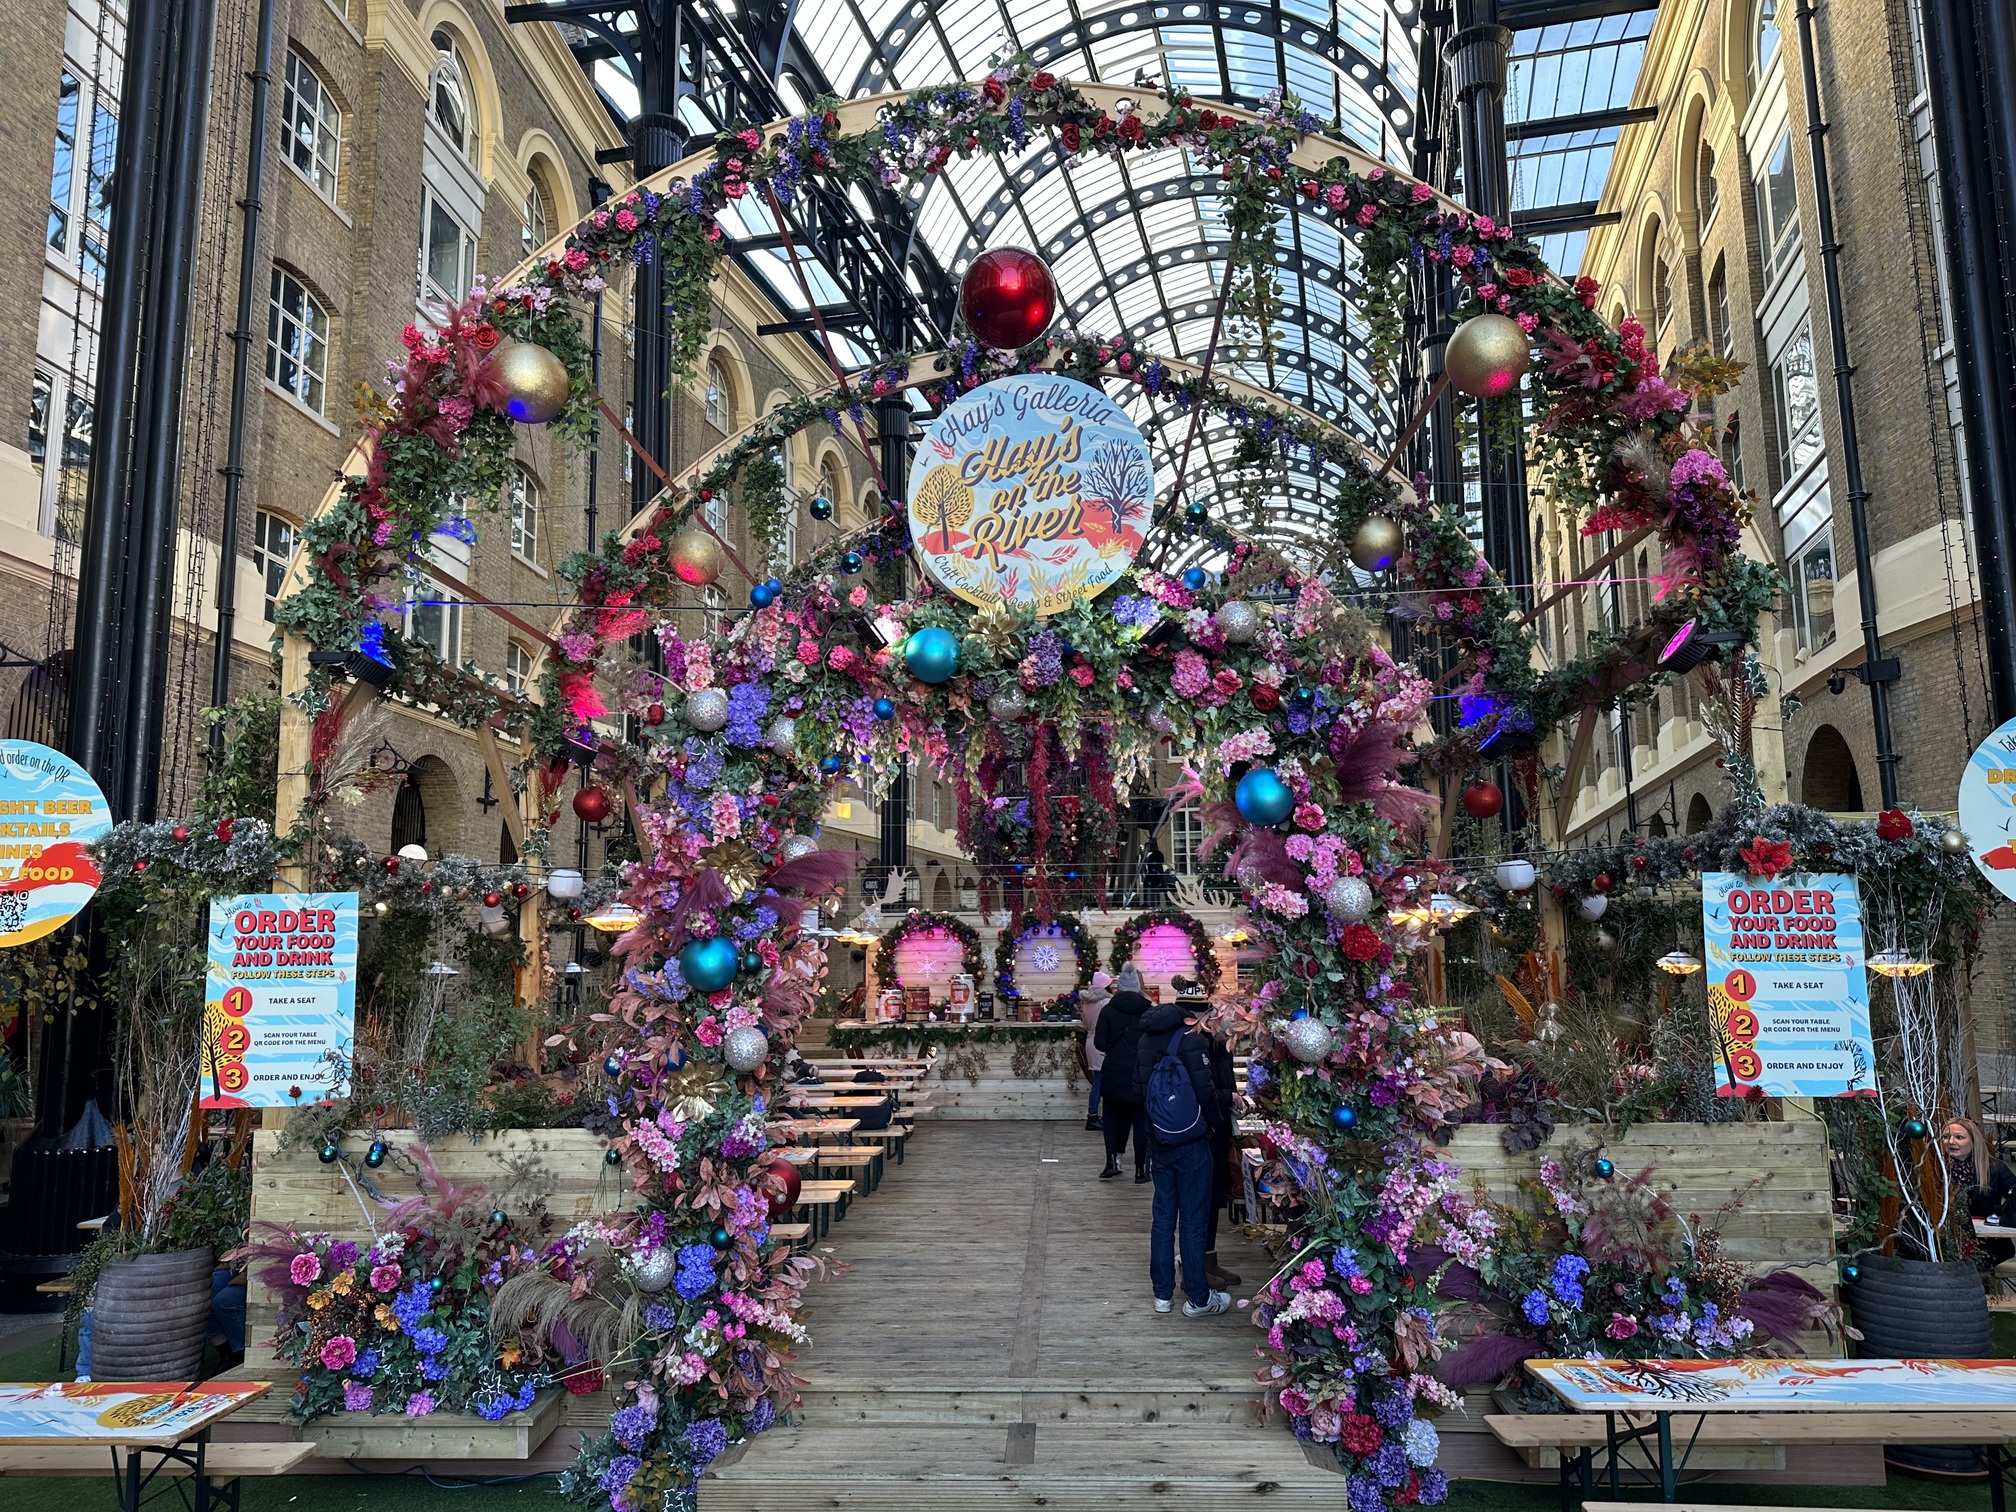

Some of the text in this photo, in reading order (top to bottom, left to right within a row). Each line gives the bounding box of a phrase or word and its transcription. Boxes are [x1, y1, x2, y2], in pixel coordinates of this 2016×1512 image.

[941, 383, 1113, 447] Hay's Galleria
[961, 416, 1083, 486] Hay's
[990, 464, 1083, 514] on the
[970, 494, 1084, 573] River
[935, 556, 959, 580] Craft
[1044, 596, 1052, 608] &
[1056, 582, 1088, 604] Street
[1088, 562, 1113, 588] Food
[7, 749, 28, 766] order
[30, 757, 40, 769] on
[42, 758, 56, 775] the
[54, 766, 70, 783] QR
[44, 800, 92, 815] BEER
[19, 866, 74, 881] FOOD
[1719, 881, 1734, 897] How
[1728, 890, 1836, 914] ORDER
[235, 910, 336, 934] ORDER
[1728, 916, 1836, 932] YOUR FOOD
[233, 934, 335, 950] YOUR FOOD
[1730, 934, 1838, 949] AND DRINK
[232, 951, 334, 967] AND DRINK
[1731, 953, 1841, 962] FOLLOW THESE STEPS
[231, 970, 334, 979] FOLLOW THESE STEPS
[1732, 974, 1747, 995] 1
[230, 992, 243, 1011] 1
[1735, 1015, 1753, 1036] 2
[227, 1030, 245, 1050] 2
[1738, 1056, 1756, 1077] 3
[225, 1068, 242, 1089] 3
